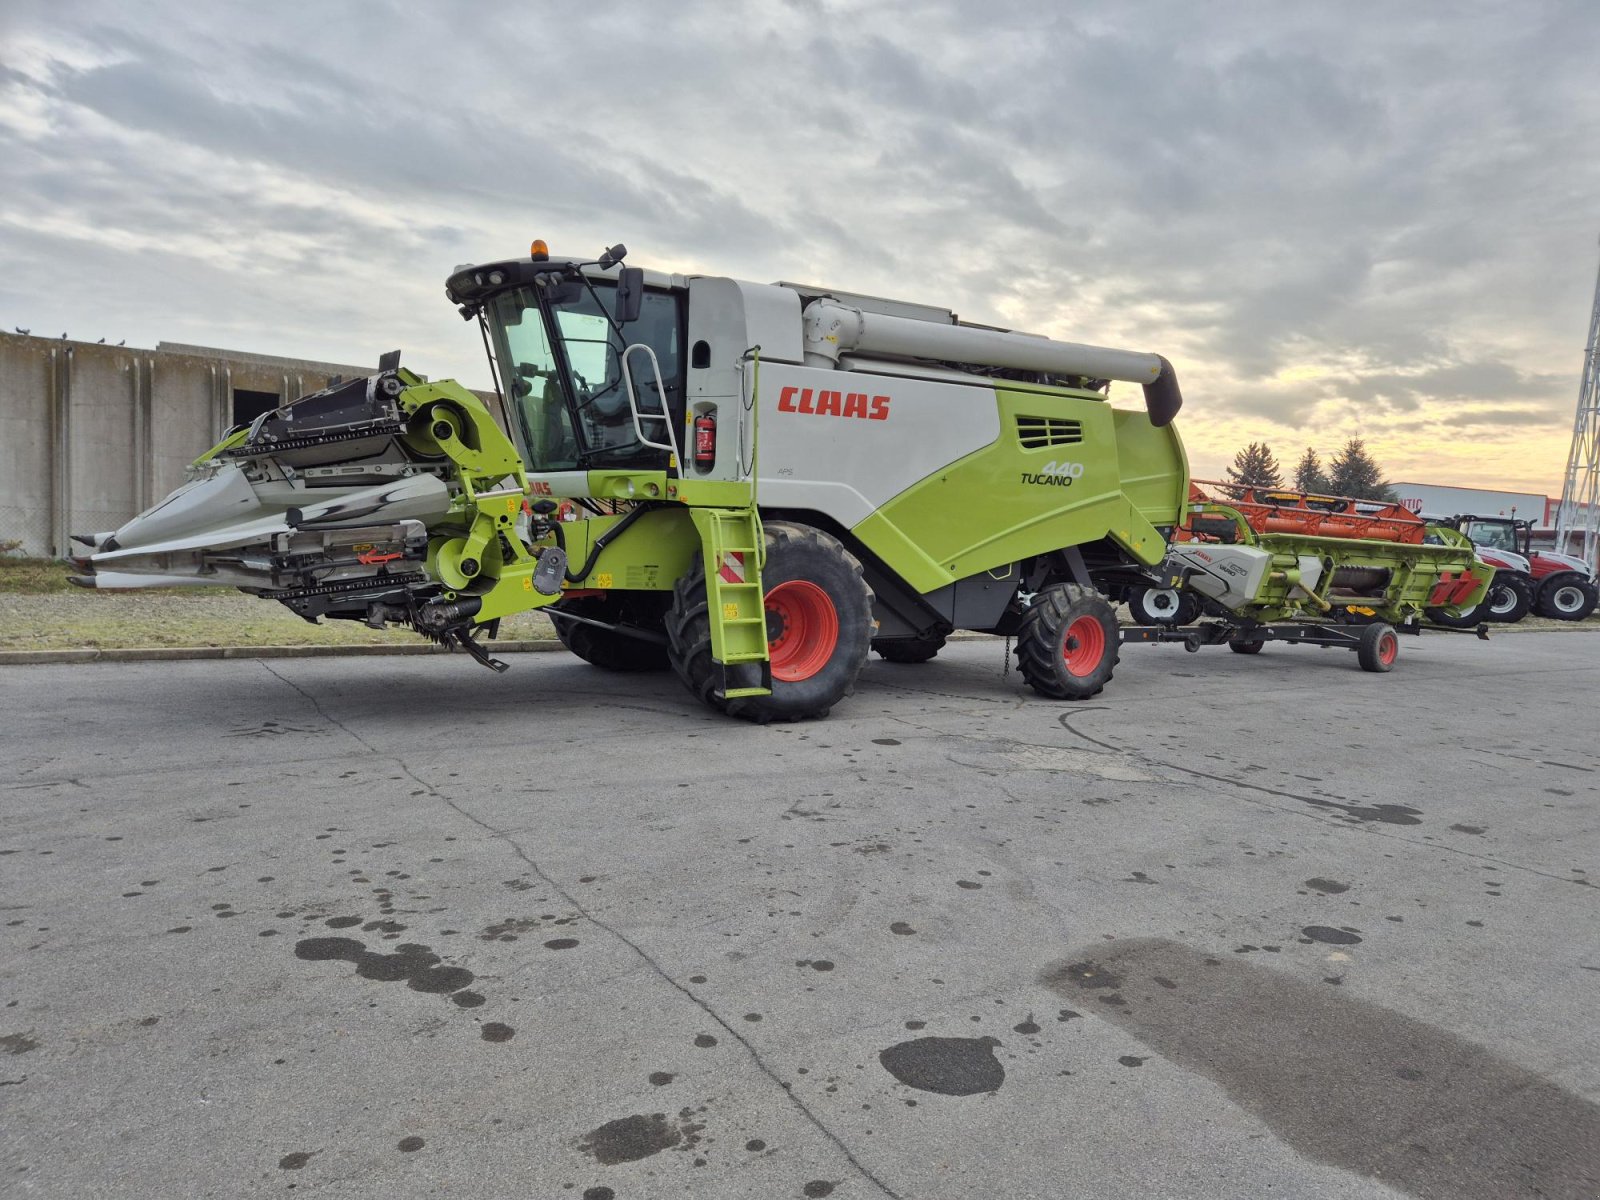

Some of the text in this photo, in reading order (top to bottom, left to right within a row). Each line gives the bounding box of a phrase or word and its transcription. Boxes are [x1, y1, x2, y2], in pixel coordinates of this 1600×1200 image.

[778, 386, 891, 420] CLAAS
[1042, 460, 1084, 478] 440
[1021, 473, 1073, 487] TUCANO
[528, 481, 552, 495] AAS
[1400, 498, 1423, 509] NTIC
[1217, 563, 1236, 577] VARIO
